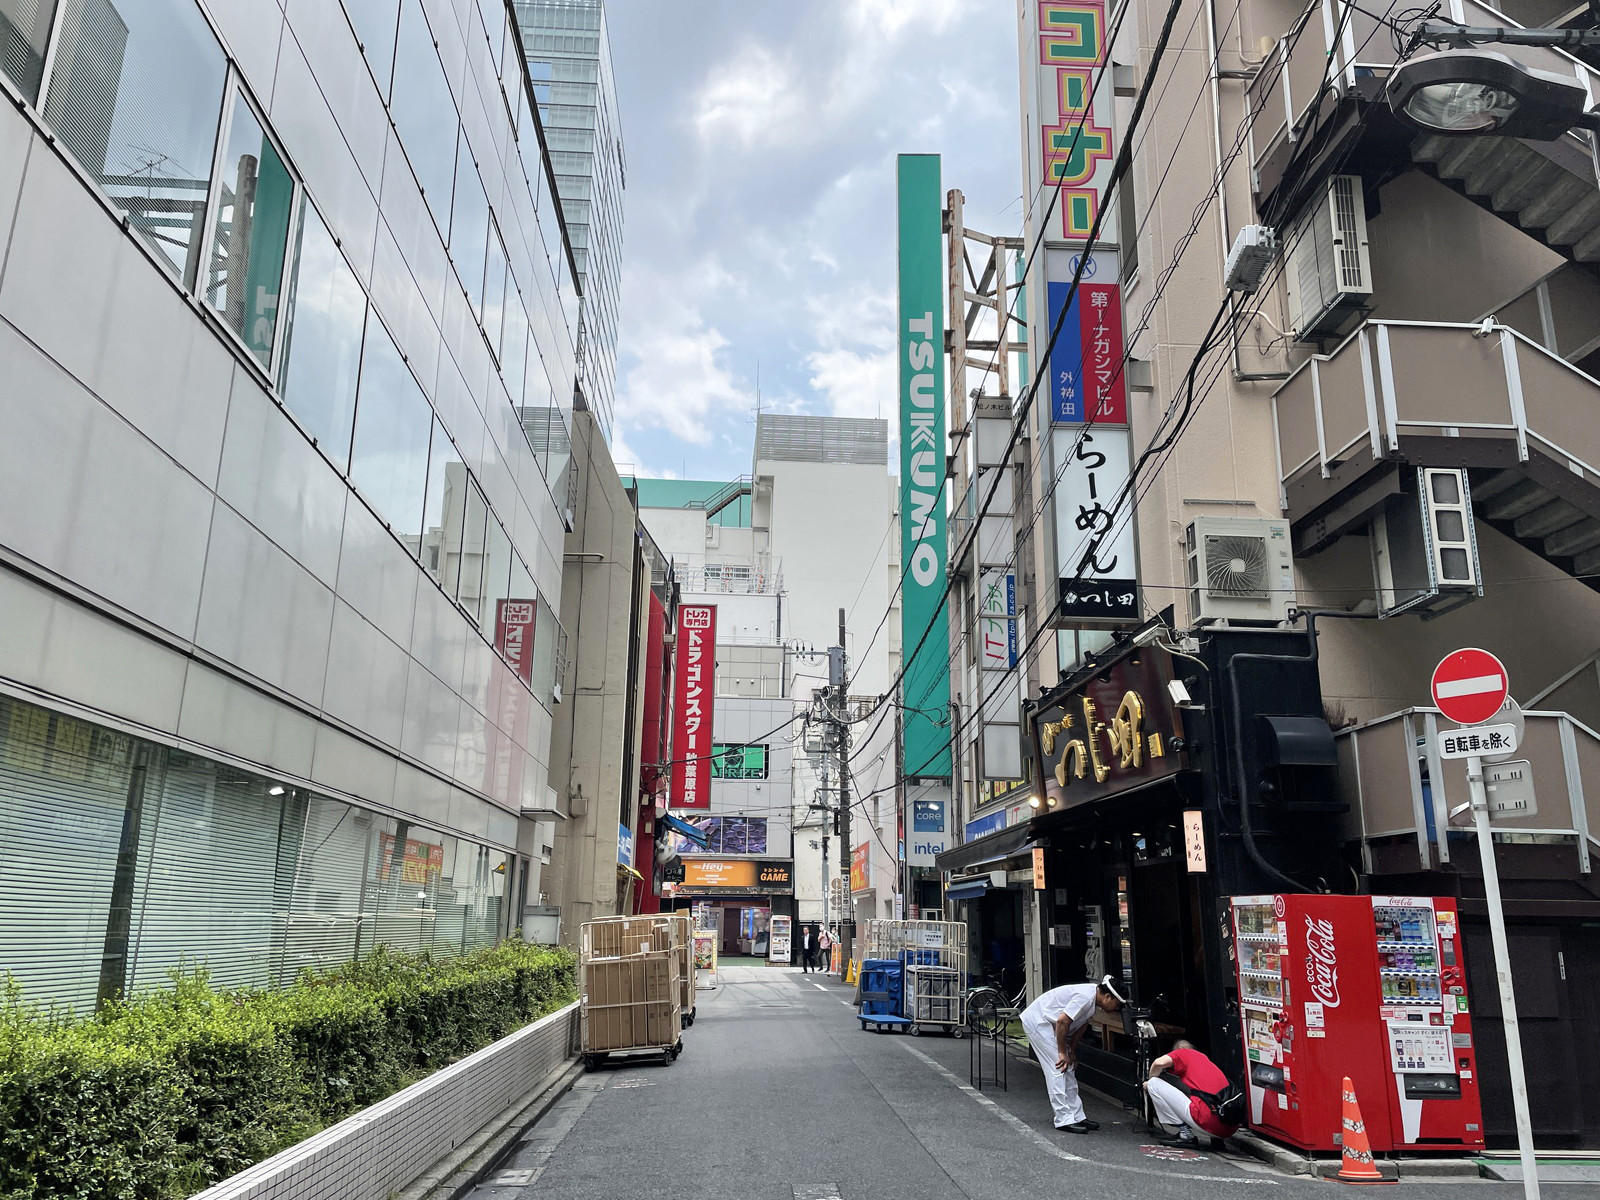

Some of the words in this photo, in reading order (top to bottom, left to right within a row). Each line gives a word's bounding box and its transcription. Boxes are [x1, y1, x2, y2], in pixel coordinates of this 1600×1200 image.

[1060, 371, 1075, 415] 外神田
[908, 312, 939, 587] TSUKUMO
[1075, 434, 1119, 574] らーめん
[1080, 590, 1135, 607] つじ田
[686, 610, 708, 618] トレカ
[685, 629, 703, 750] ドラゴンスター
[1444, 732, 1511, 753] 自転車を除く
[914, 841, 945, 855] intel
[1193, 823, 1202, 861] らーめん
[701, 863, 724, 873] Hey
[760, 873, 789, 881] GAME
[1304, 913, 1341, 1008] Coca-Cola
